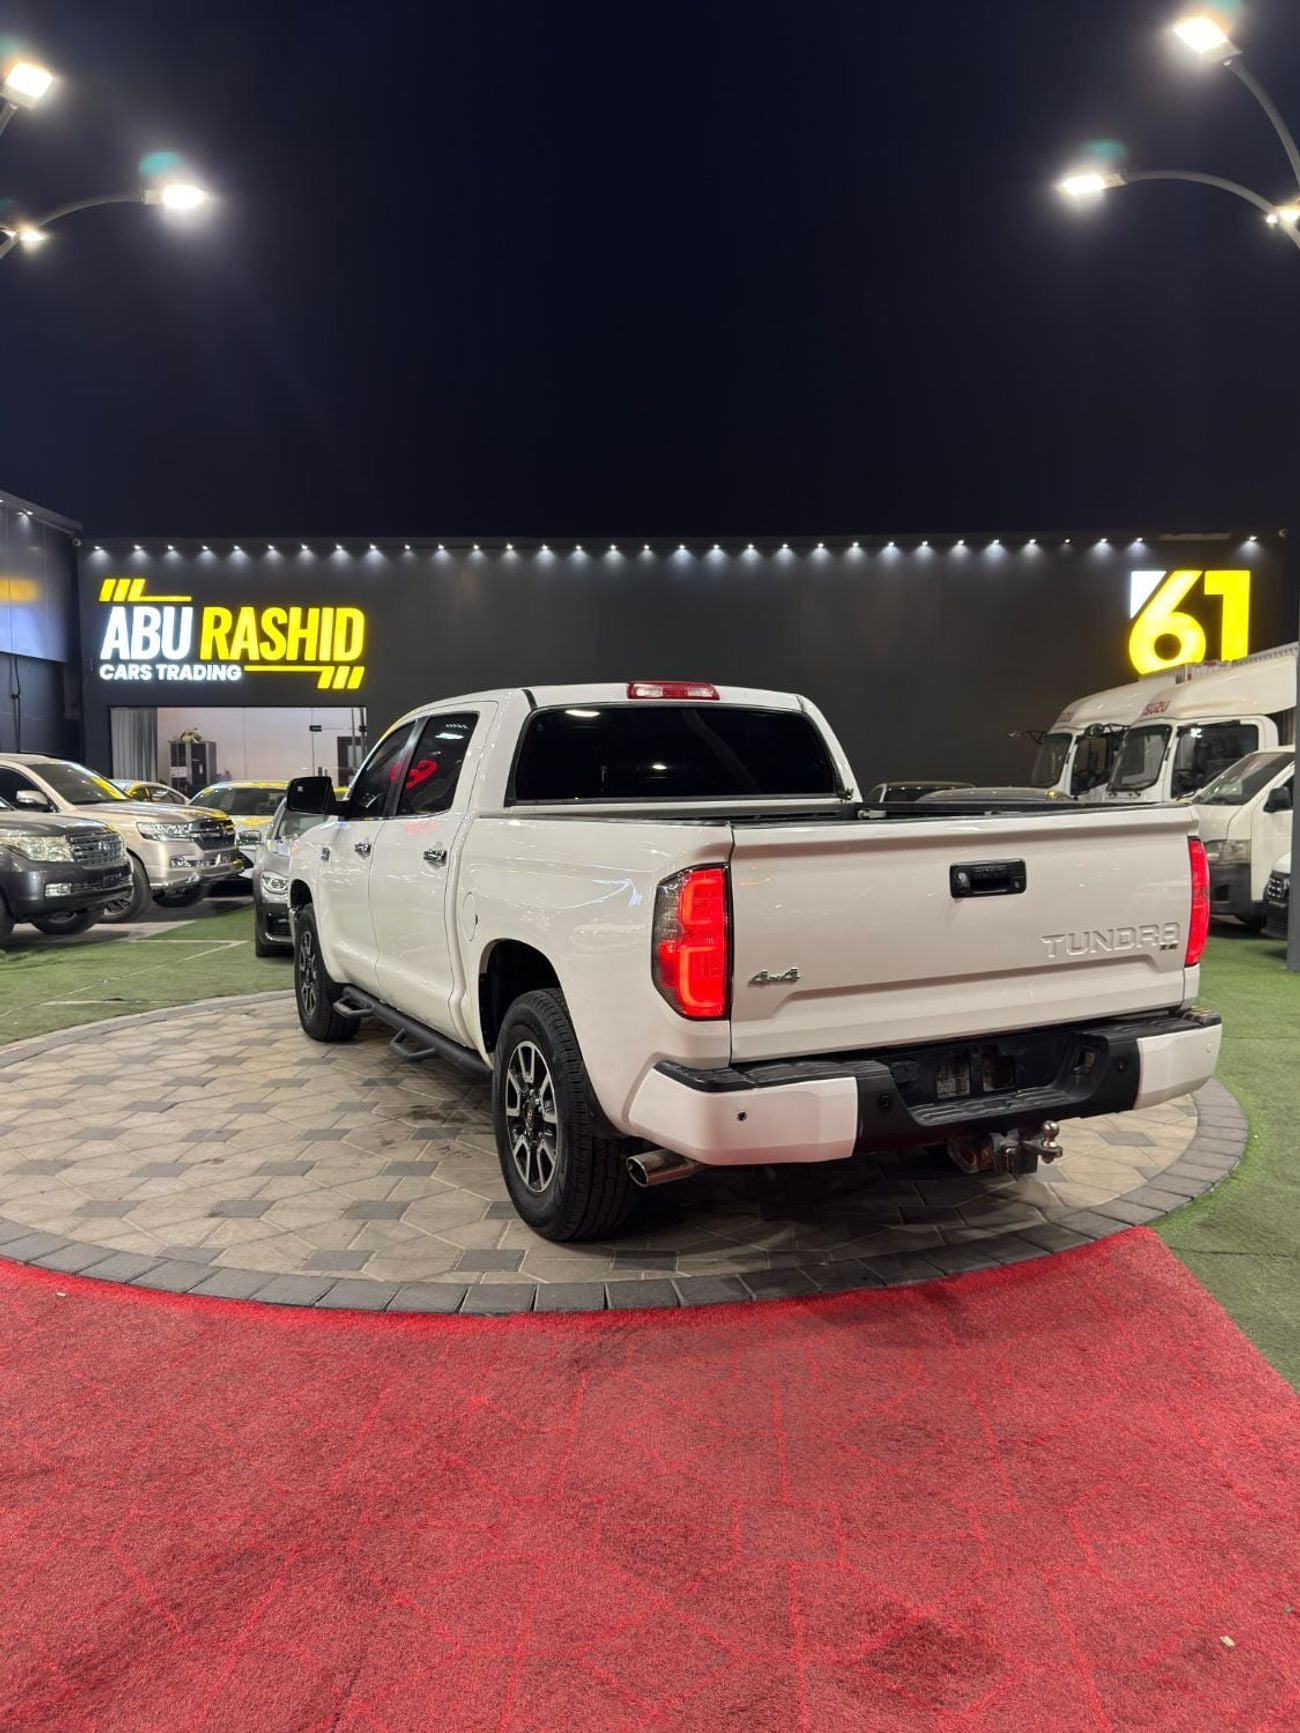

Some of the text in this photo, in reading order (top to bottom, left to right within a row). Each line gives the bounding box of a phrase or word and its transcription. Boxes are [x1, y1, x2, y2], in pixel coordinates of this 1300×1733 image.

[100, 606, 366, 661] ABU RASHID
[1129, 569, 1251, 675] 61
[99, 664, 242, 681] CARS TRADING
[1041, 921, 1181, 958] TUNDRA
